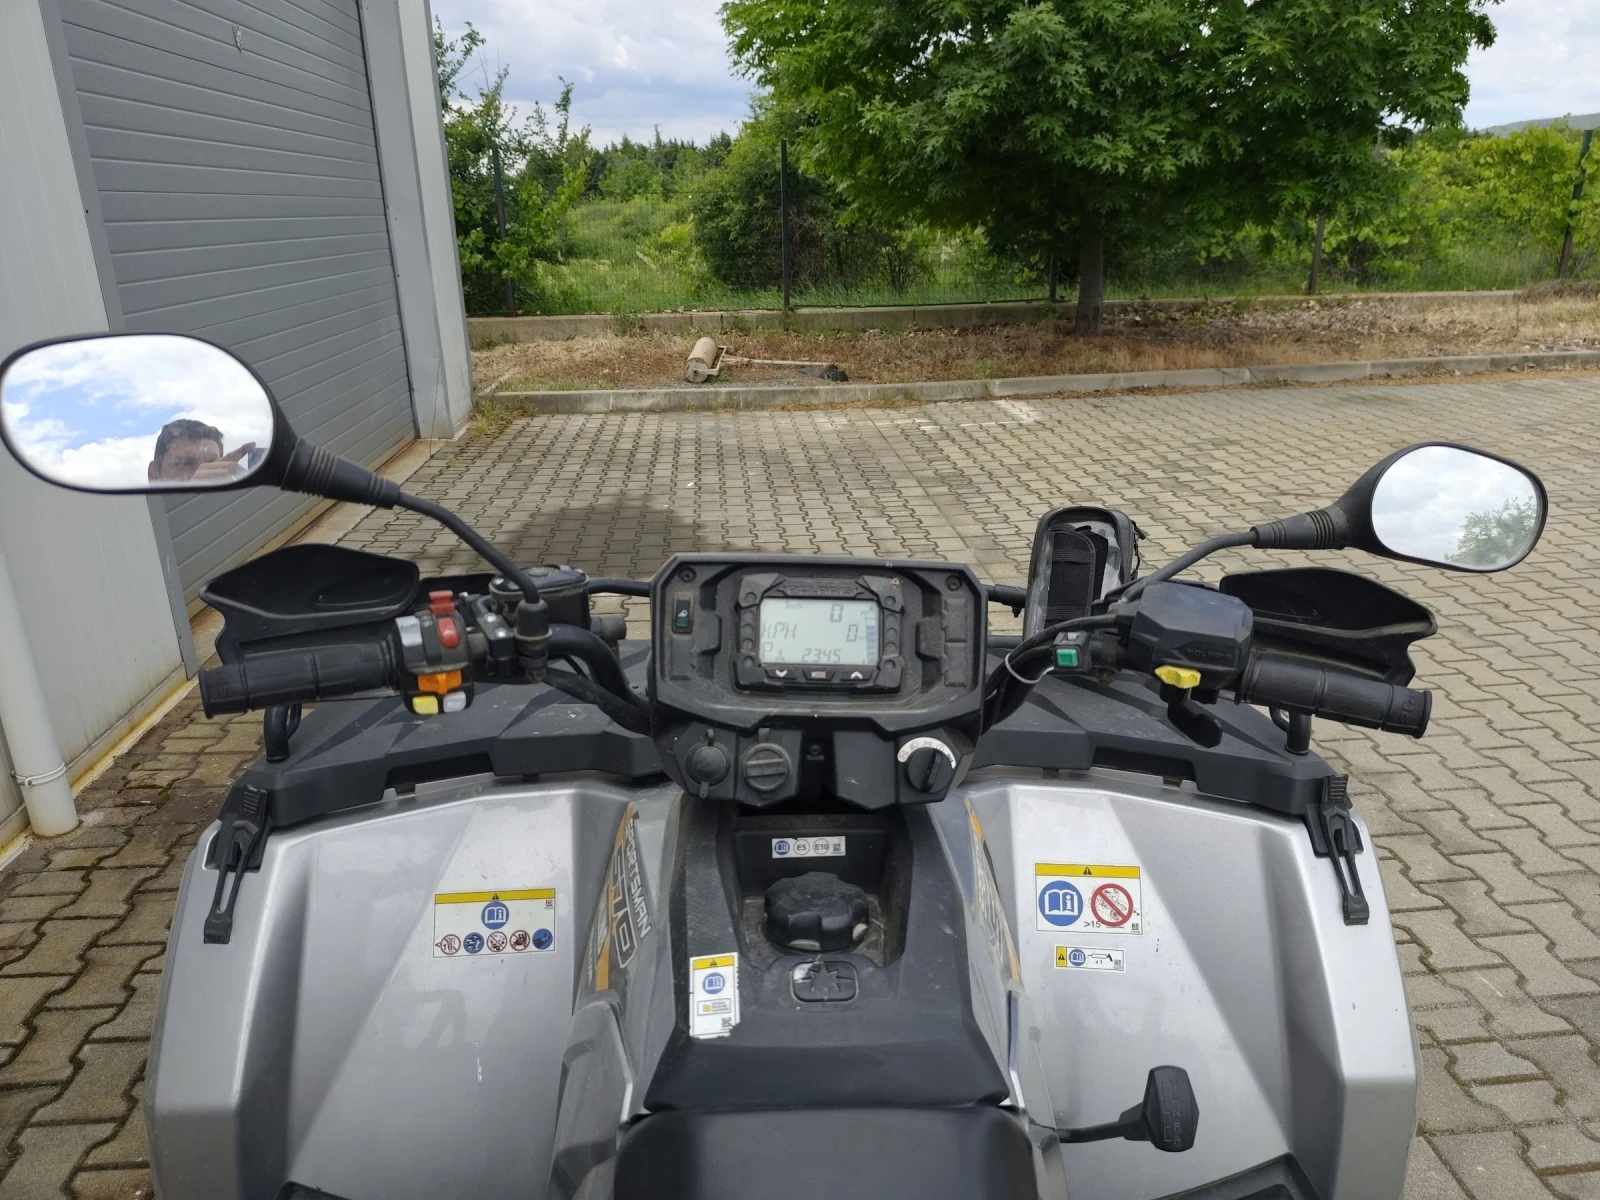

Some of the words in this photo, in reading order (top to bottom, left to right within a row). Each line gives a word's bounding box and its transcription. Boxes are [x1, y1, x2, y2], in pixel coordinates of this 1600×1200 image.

[787, 585, 854, 595] POLARIS
[846, 624, 859, 642] 0
[811, 670, 826, 679] MODE
[814, 843, 829, 851] E10
[625, 817, 653, 940] SPORTSMAN
